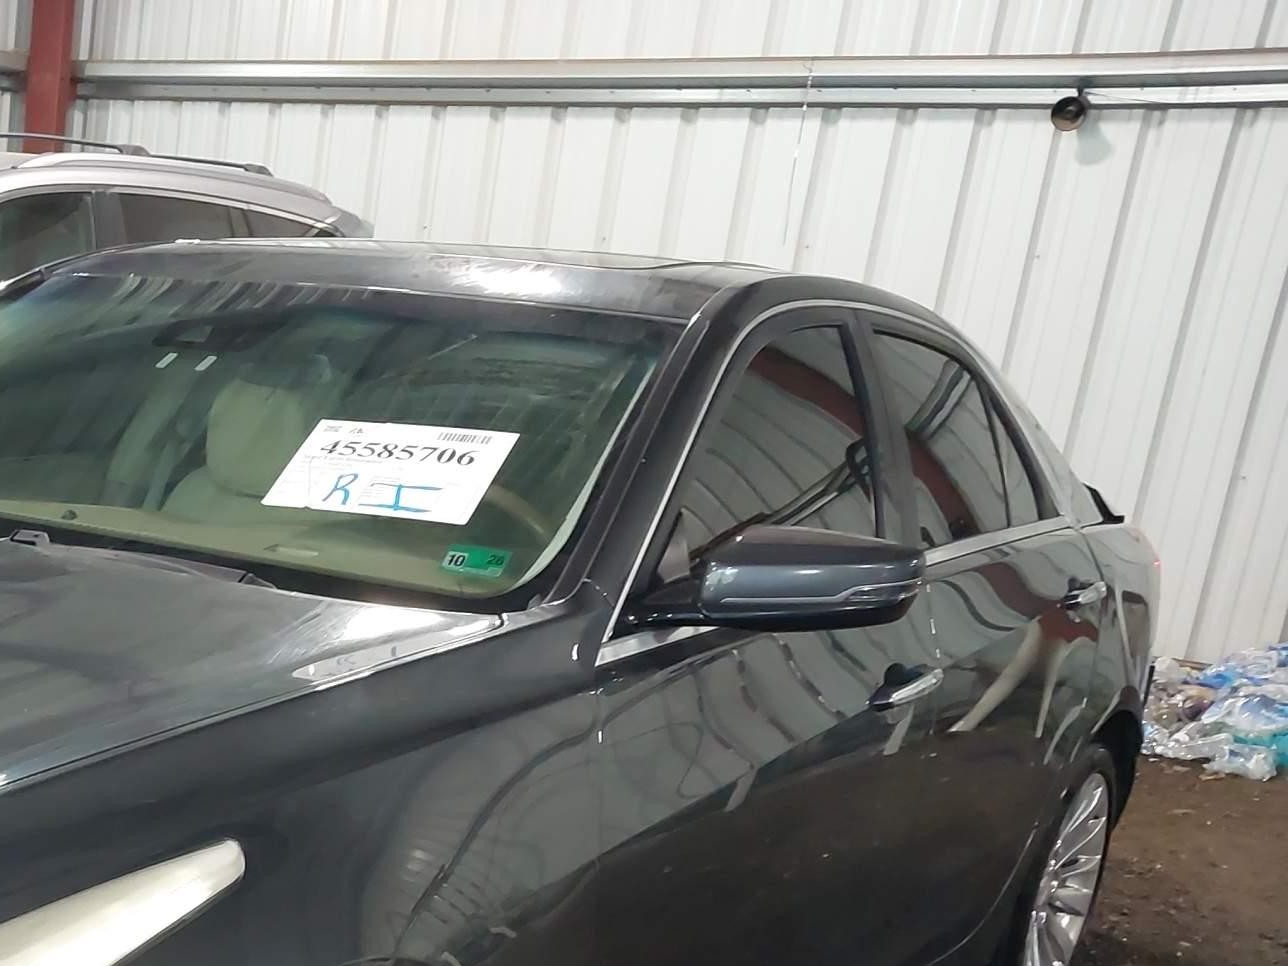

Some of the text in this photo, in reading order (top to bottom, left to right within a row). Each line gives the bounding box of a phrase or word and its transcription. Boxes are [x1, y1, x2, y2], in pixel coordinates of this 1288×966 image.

[320, 440, 482, 467] 45585706
[322, 473, 359, 505] R
[447, 554, 466, 567] 10
